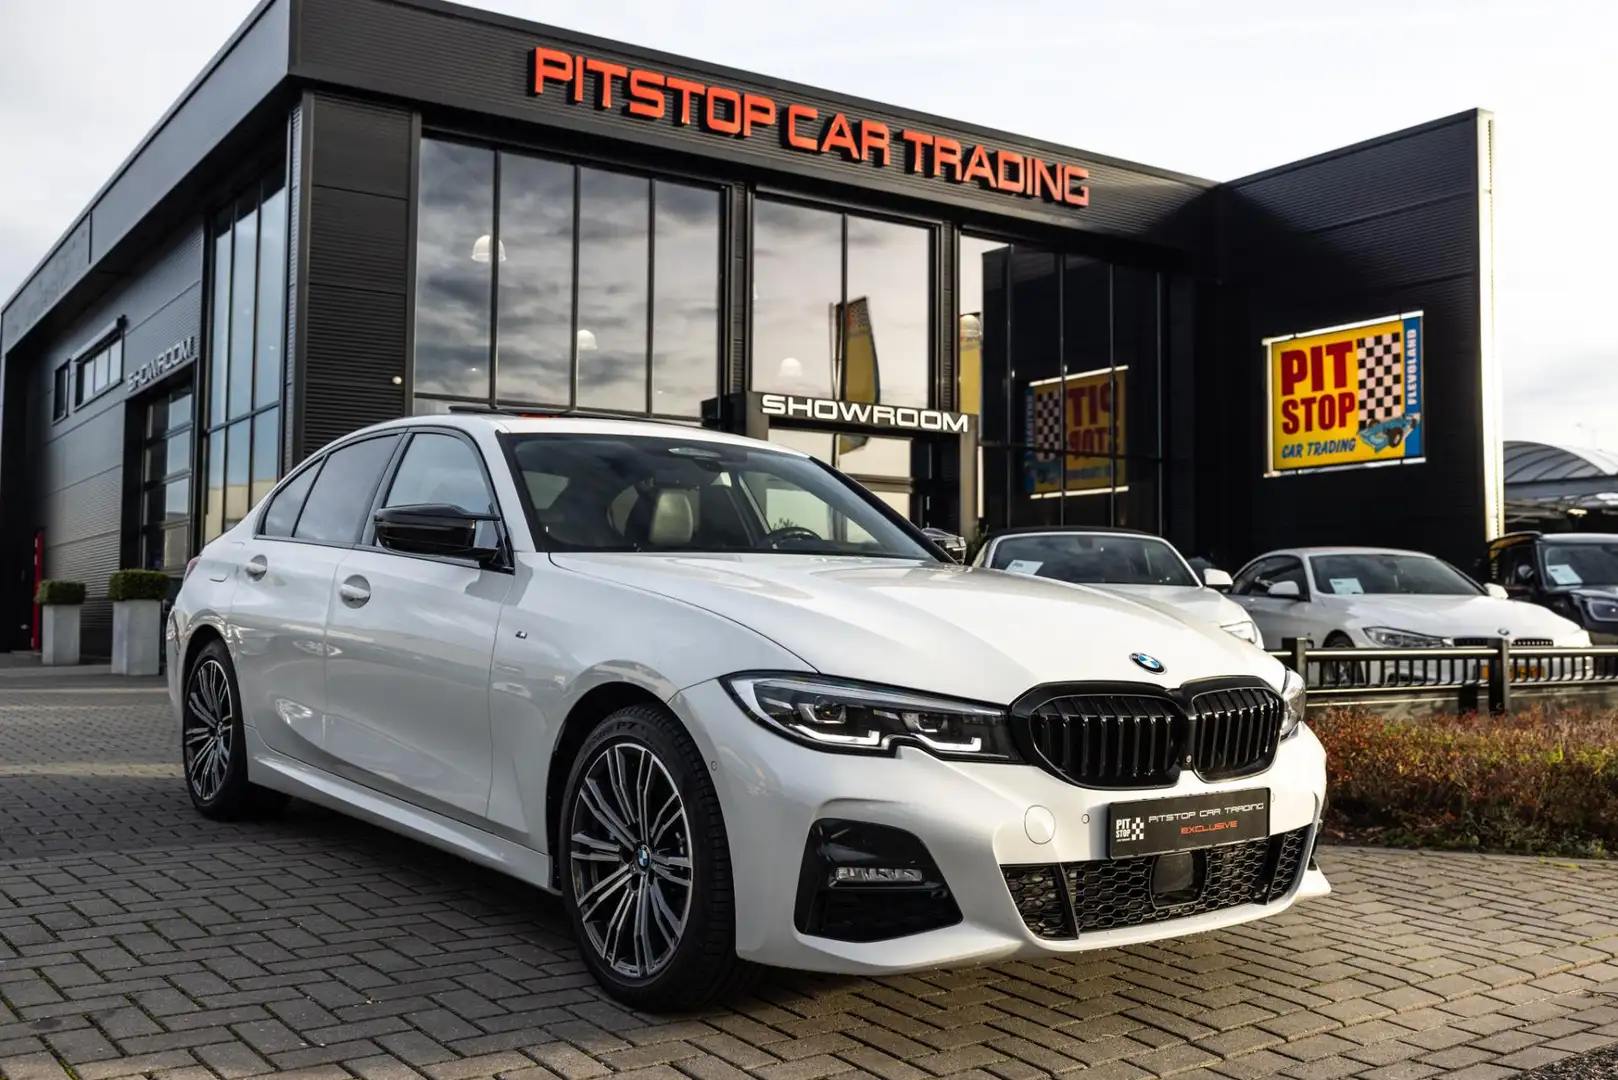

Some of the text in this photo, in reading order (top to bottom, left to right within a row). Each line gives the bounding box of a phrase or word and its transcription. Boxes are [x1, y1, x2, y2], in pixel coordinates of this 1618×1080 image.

[531, 46, 1089, 207] PITSTOP CAR TRADING
[1280, 340, 1353, 397] PIT
[1406, 328, 1418, 406] FLEVOLAND
[761, 394, 969, 432] SHOWROOM
[1281, 391, 1356, 436] STOP
[1281, 437, 1357, 459] CAR TRADING
[1115, 817, 1131, 830] PIT
[1148, 802, 1264, 823] PITSTOP CAR TRADING
[1180, 820, 1238, 835] EXCLUSIVE
[1115, 829, 1131, 839] STOP
